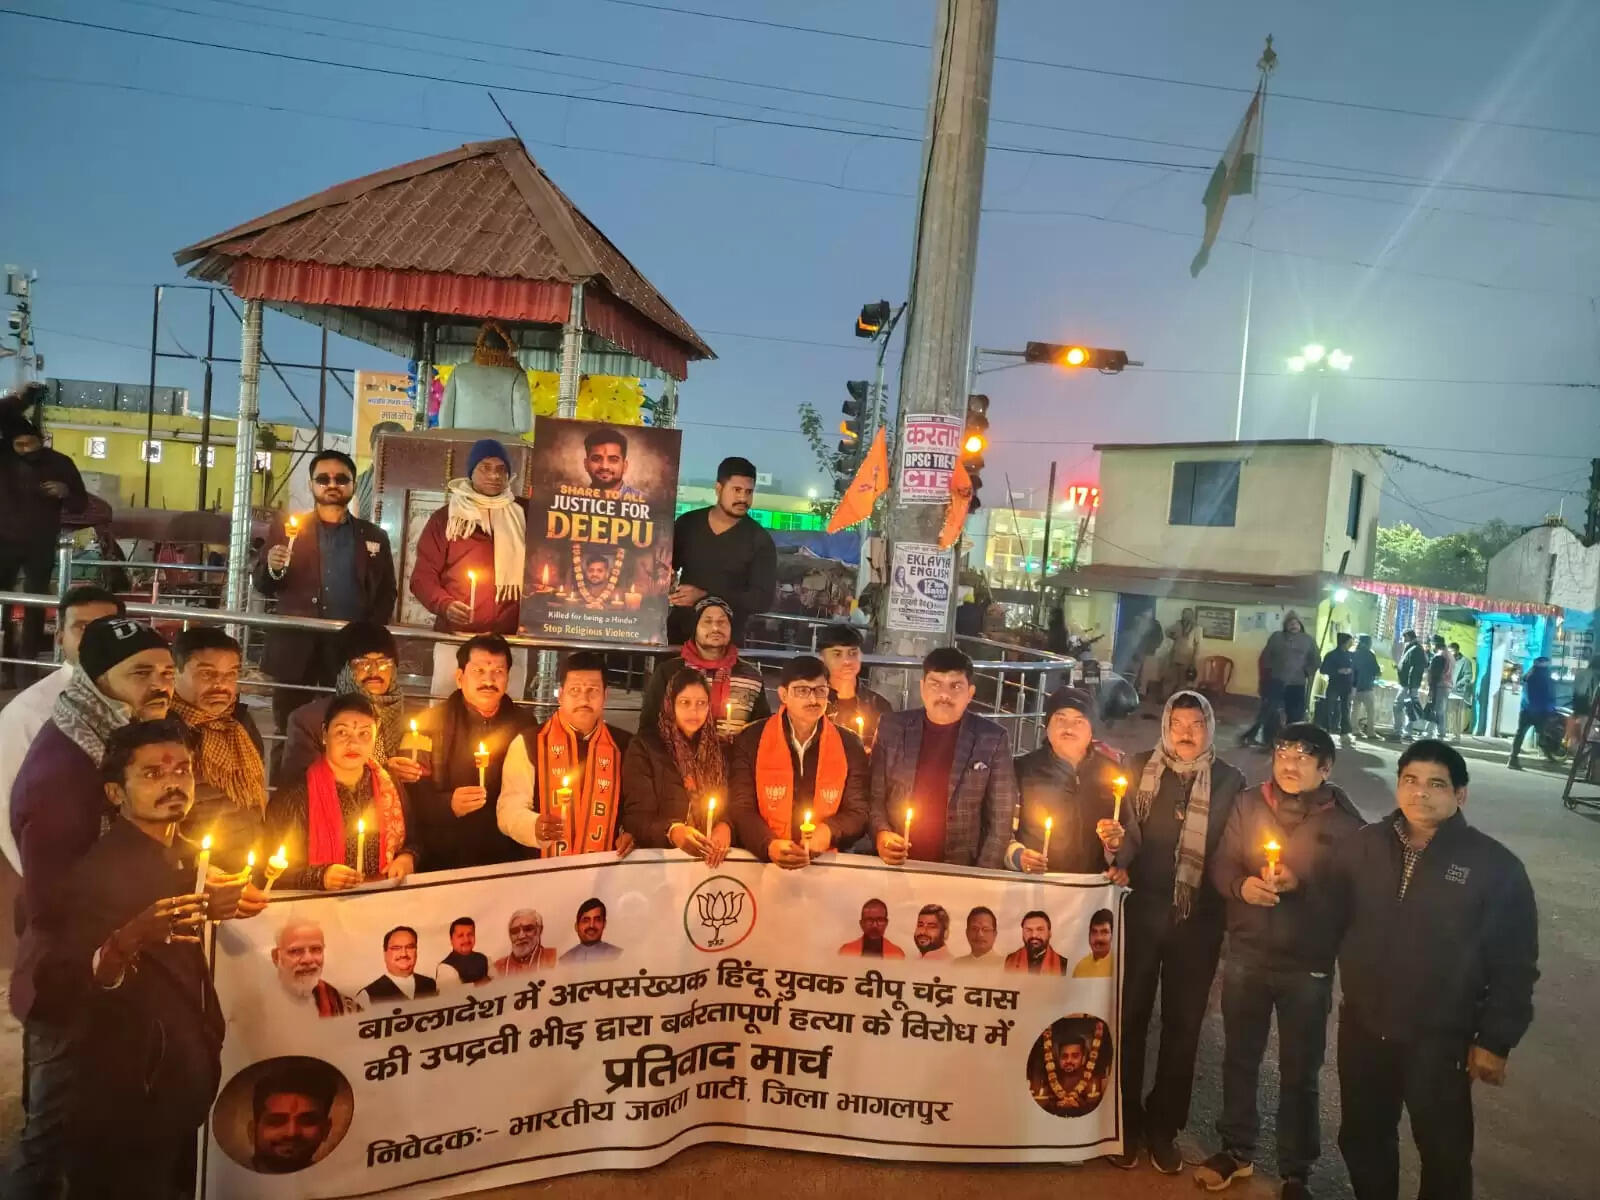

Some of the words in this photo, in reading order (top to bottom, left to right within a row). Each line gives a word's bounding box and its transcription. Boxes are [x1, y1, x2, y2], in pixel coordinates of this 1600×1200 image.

[560, 484, 601, 498] SHARE
[605, 489, 620, 500] TO
[623, 492, 645, 503] ALL
[550, 495, 616, 516] JUSTICE
[620, 502, 650, 519] FOR
[546, 511, 654, 548] DEEPU
[907, 554, 951, 569] EKLAVYA
[910, 566, 949, 579] ENGLISH
[548, 611, 570, 620] Killed
[571, 613, 582, 621] for
[543, 623, 563, 635] Stop
[564, 625, 603, 637] Religious
[605, 628, 640, 639] Violence
[358, 995, 506, 1041] बांग्लादेश
[514, 979, 546, 1011] में
[549, 967, 711, 1006] अल्पसंख्यक
[716, 958, 771, 998] हिंदू
[775, 967, 847, 1001] युवक
[855, 970, 907, 1011] दीपू
[913, 976, 955, 1008] चंद्र
[964, 985, 1019, 1010] दास
[364, 1044, 410, 1082] की
[420, 1021, 521, 1070] उपद्रवी
[529, 1016, 587, 1050] भीड़
[595, 1015, 652, 1041] द्वारा
[660, 998, 784, 1034] बर्बरतापूर्ण
[789, 1006, 854, 1036] हत्या
[862, 1009, 891, 1037] के
[901, 1012, 977, 1044] विरोध
[984, 1019, 1015, 1047] में
[603, 1041, 741, 1095] प्रतिवाद
[750, 1043, 833, 1079] मार्च
[509, 1099, 615, 1136] भारतीय
[625, 1088, 688, 1121] जनता
[762, 1080, 829, 1110] जिला
[836, 1092, 953, 1125] भागलपुर
